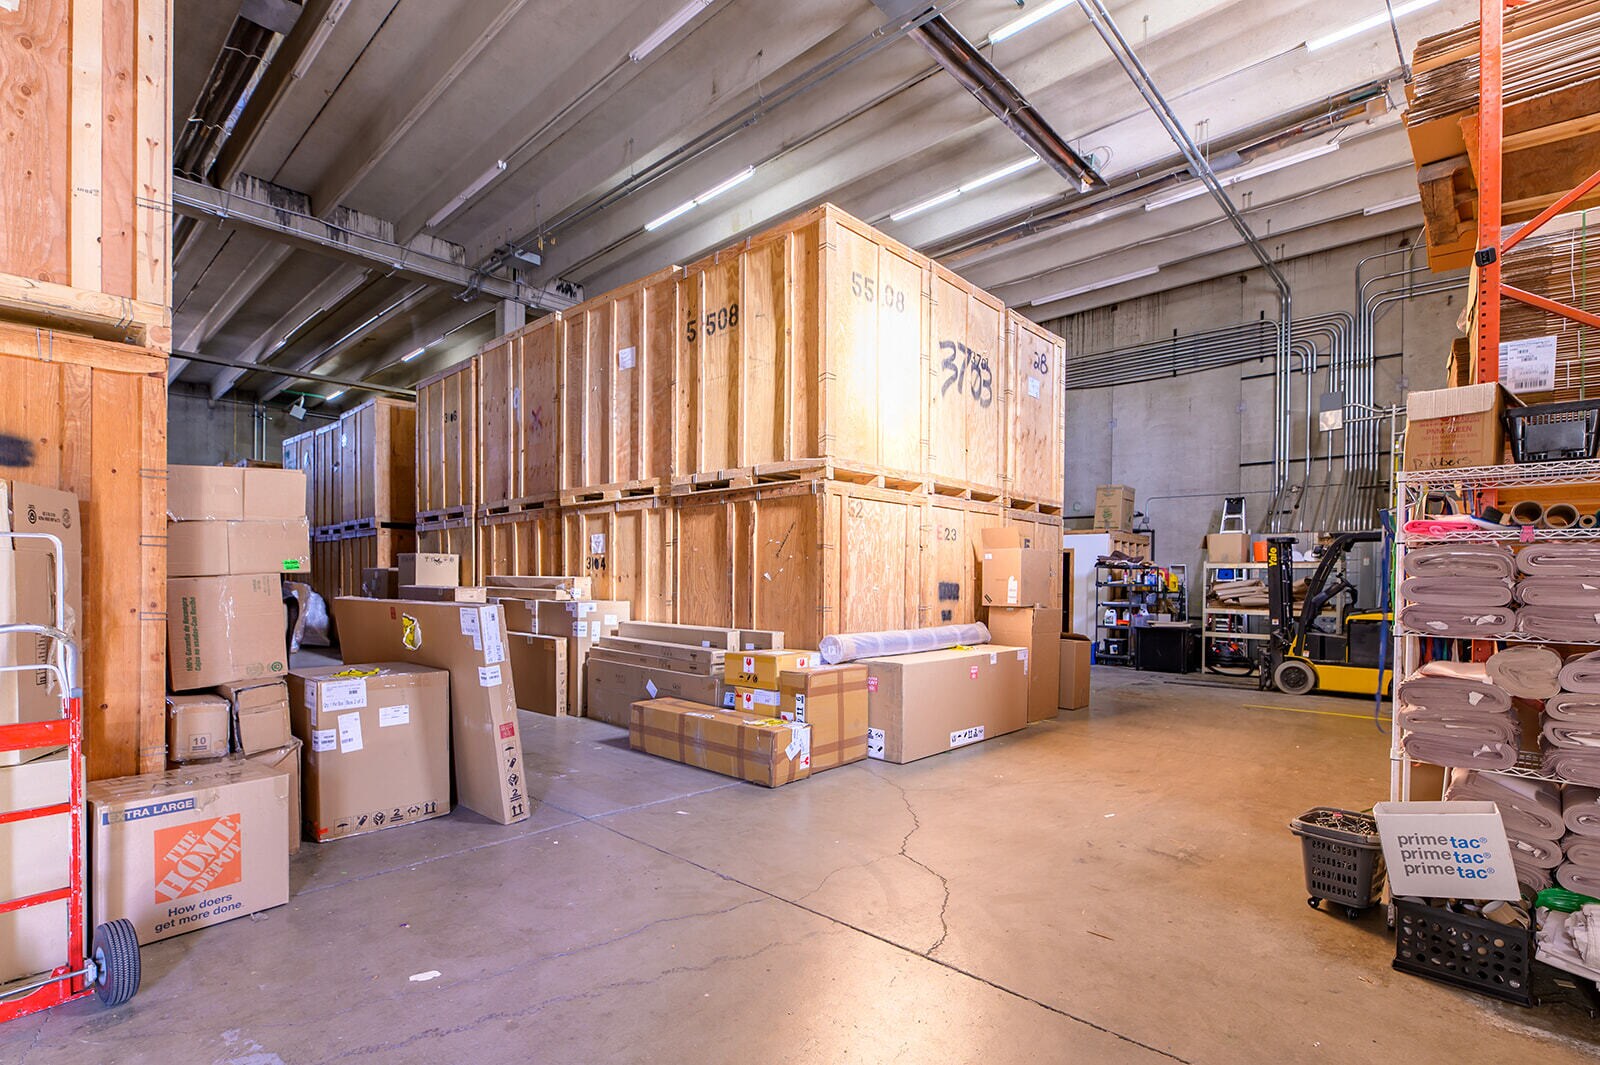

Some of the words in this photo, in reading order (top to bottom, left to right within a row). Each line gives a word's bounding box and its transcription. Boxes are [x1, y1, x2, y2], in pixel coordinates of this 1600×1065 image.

[1033, 352, 1049, 375] 28
[193, 736, 207, 746] 10
[153, 799, 193, 814] LARGE
[155, 815, 241, 900] HOME
[163, 830, 200, 863] THE
[190, 839, 241, 892] DEPOT
[168, 903, 196, 918] How
[199, 894, 233, 909] doers
[155, 919, 176, 934] get
[178, 910, 210, 926] more
